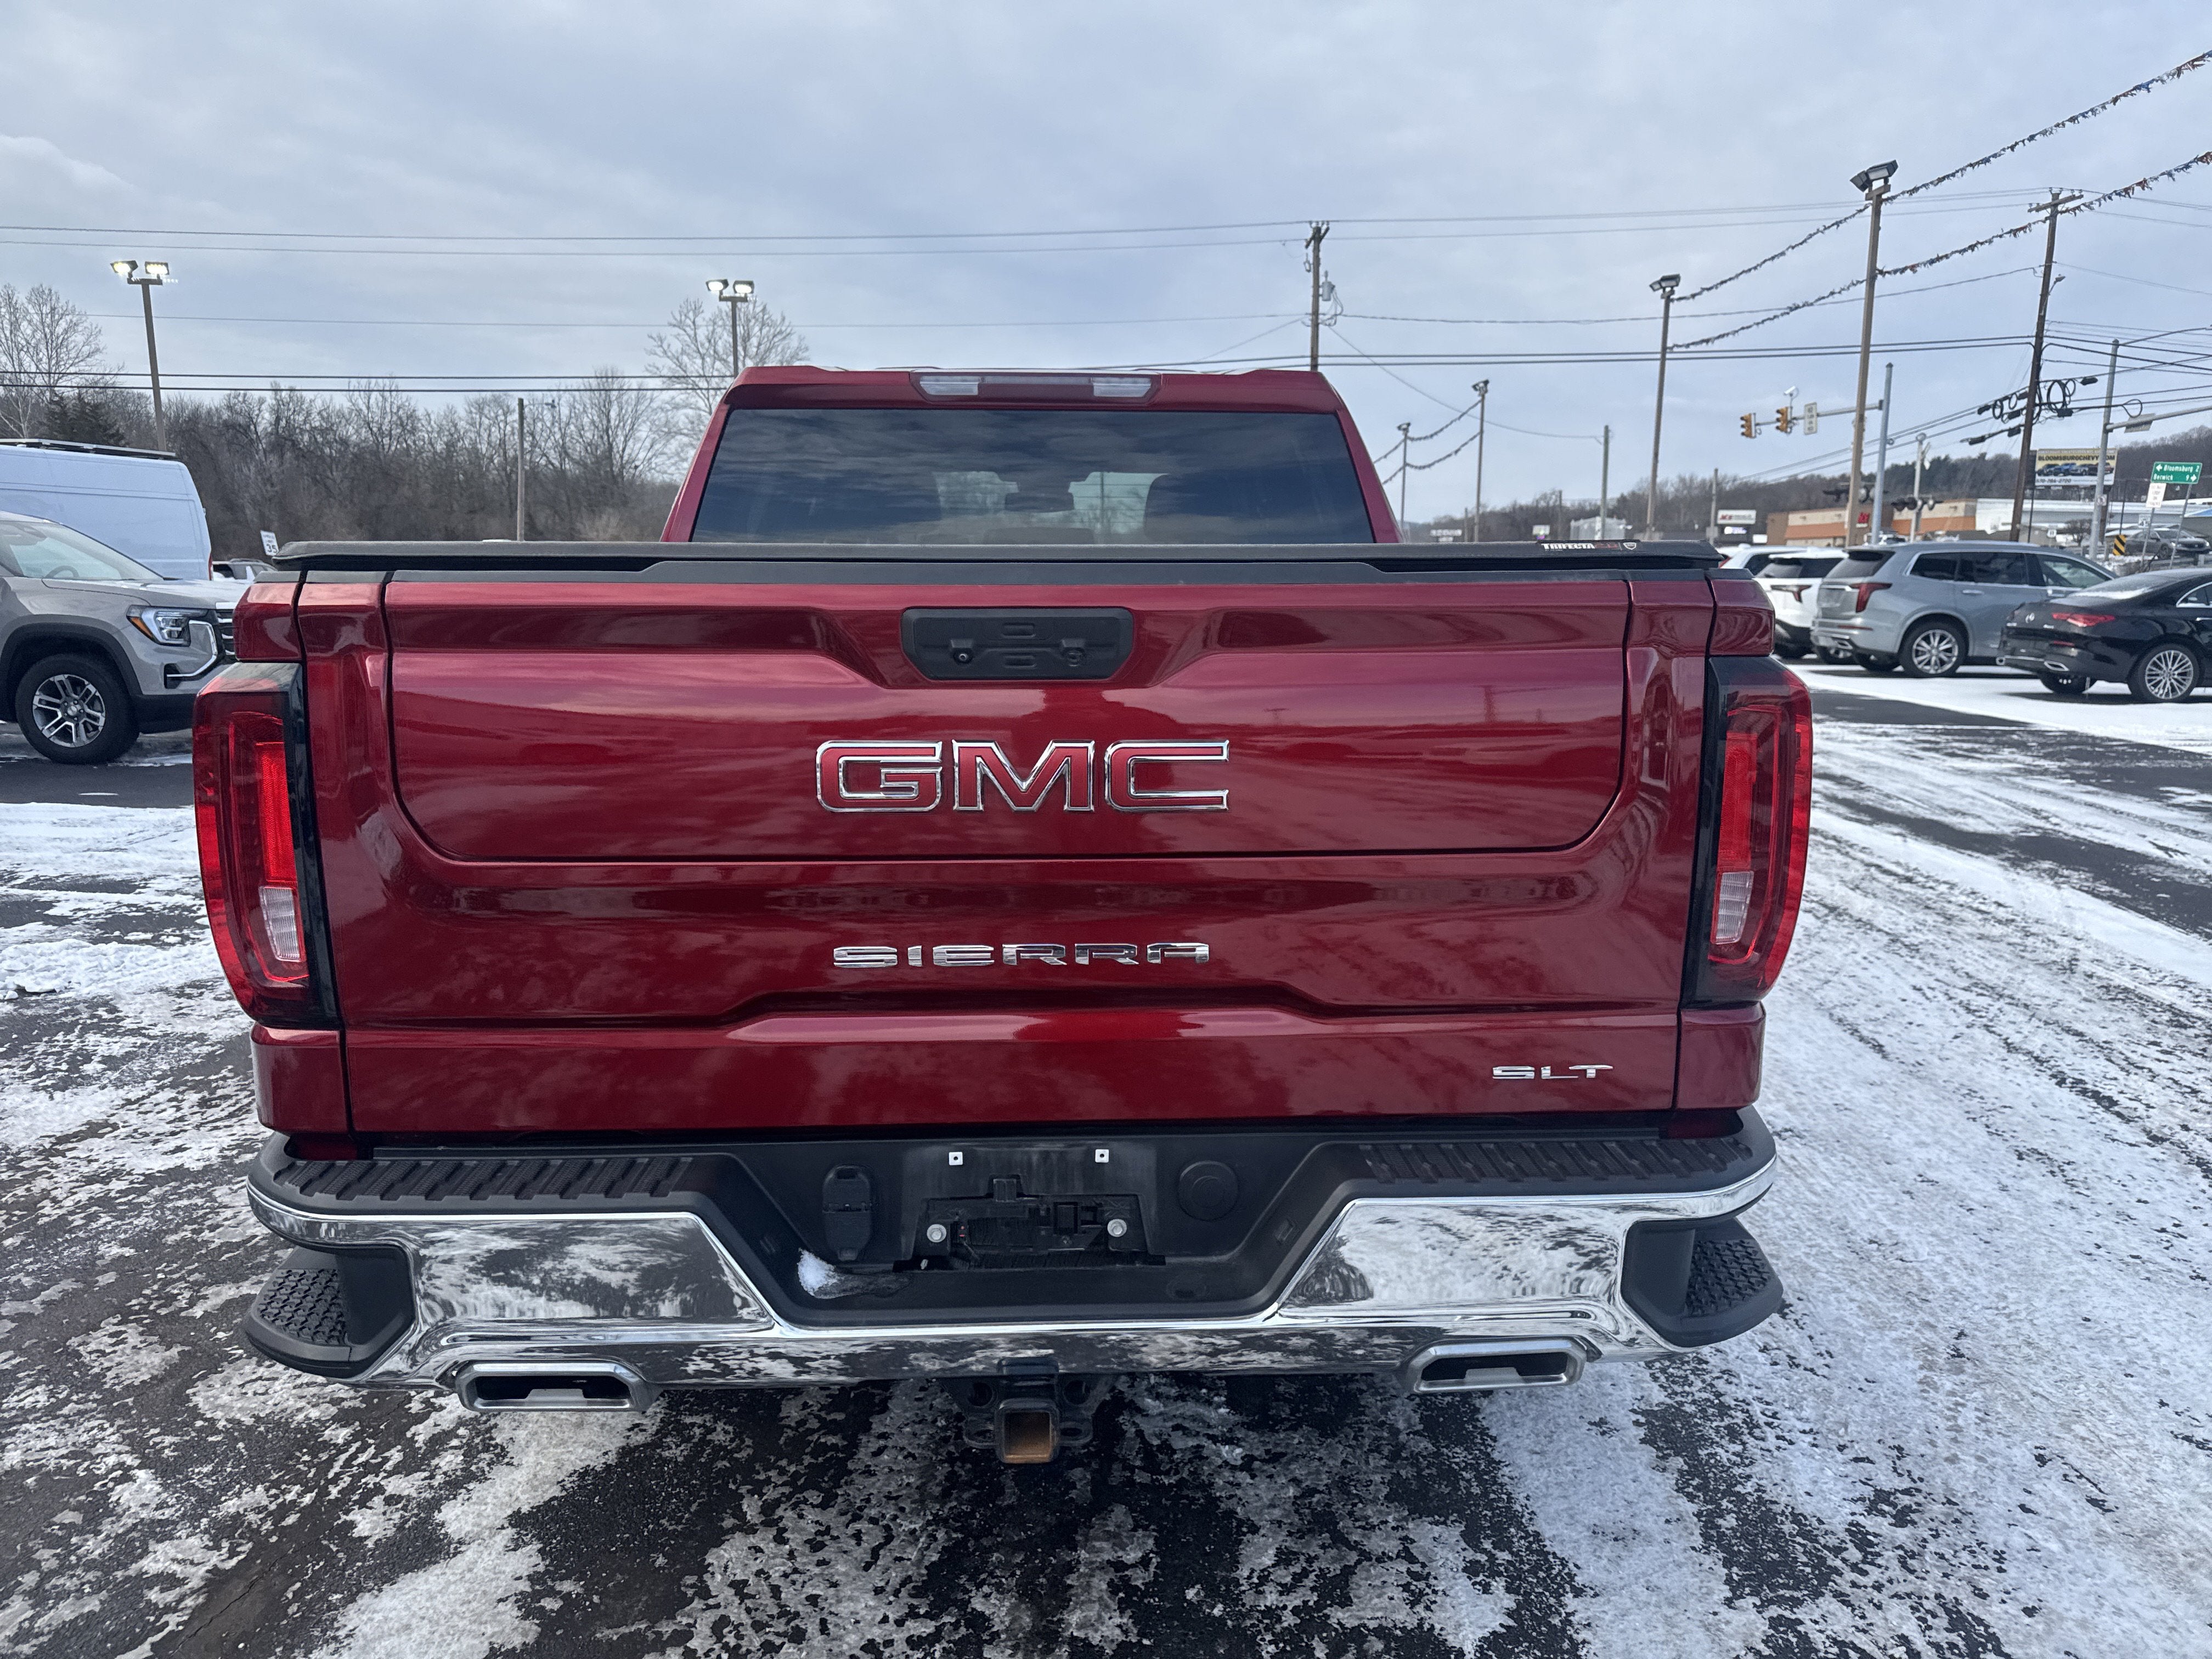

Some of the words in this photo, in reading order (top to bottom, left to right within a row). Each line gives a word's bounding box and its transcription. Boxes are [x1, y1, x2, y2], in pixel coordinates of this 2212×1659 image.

[2163, 464, 2193, 473] Bloomsburg
[266, 544, 277, 553] 35
[816, 739, 1229, 812] GMC
[833, 942, 1210, 969] SIERRA
[1492, 1065, 1613, 1079] SLT
